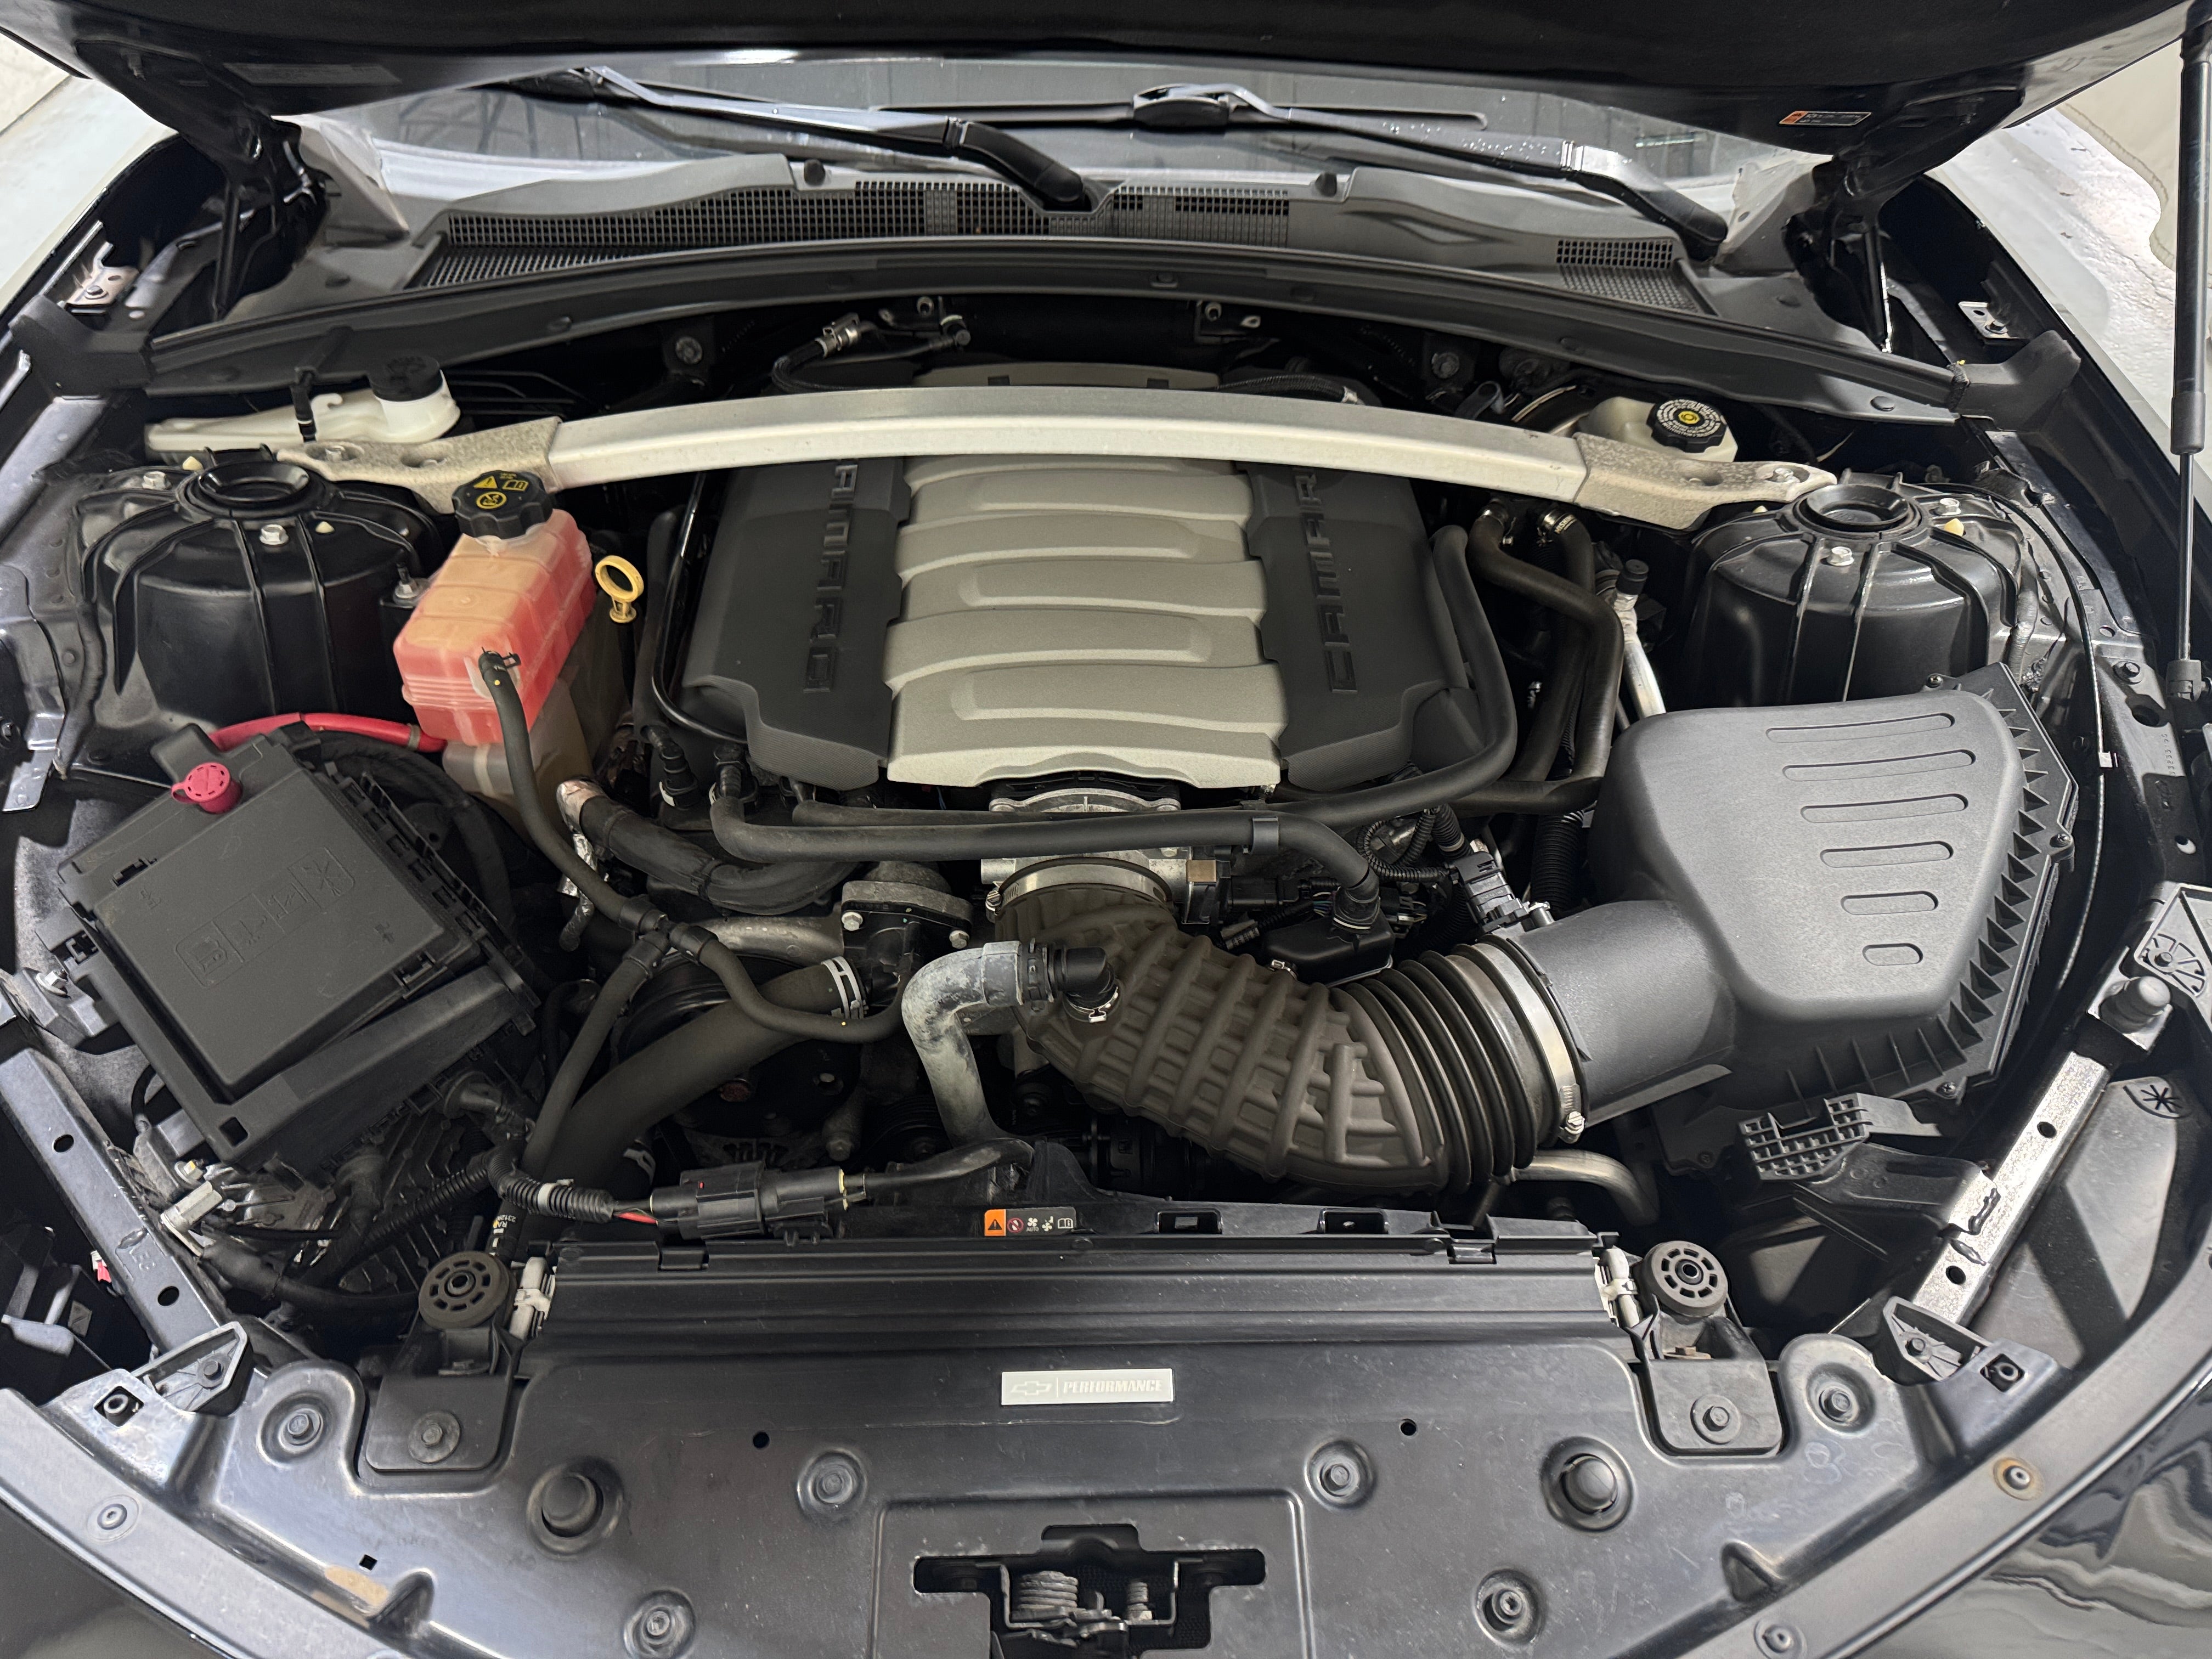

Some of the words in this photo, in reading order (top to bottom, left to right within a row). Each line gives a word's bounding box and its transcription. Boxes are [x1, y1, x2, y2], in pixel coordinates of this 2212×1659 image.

[803, 463, 859, 693] AMARO
[1293, 469, 1358, 693] CAMAR
[1063, 1379, 1163, 1393] PERFORMANCE
